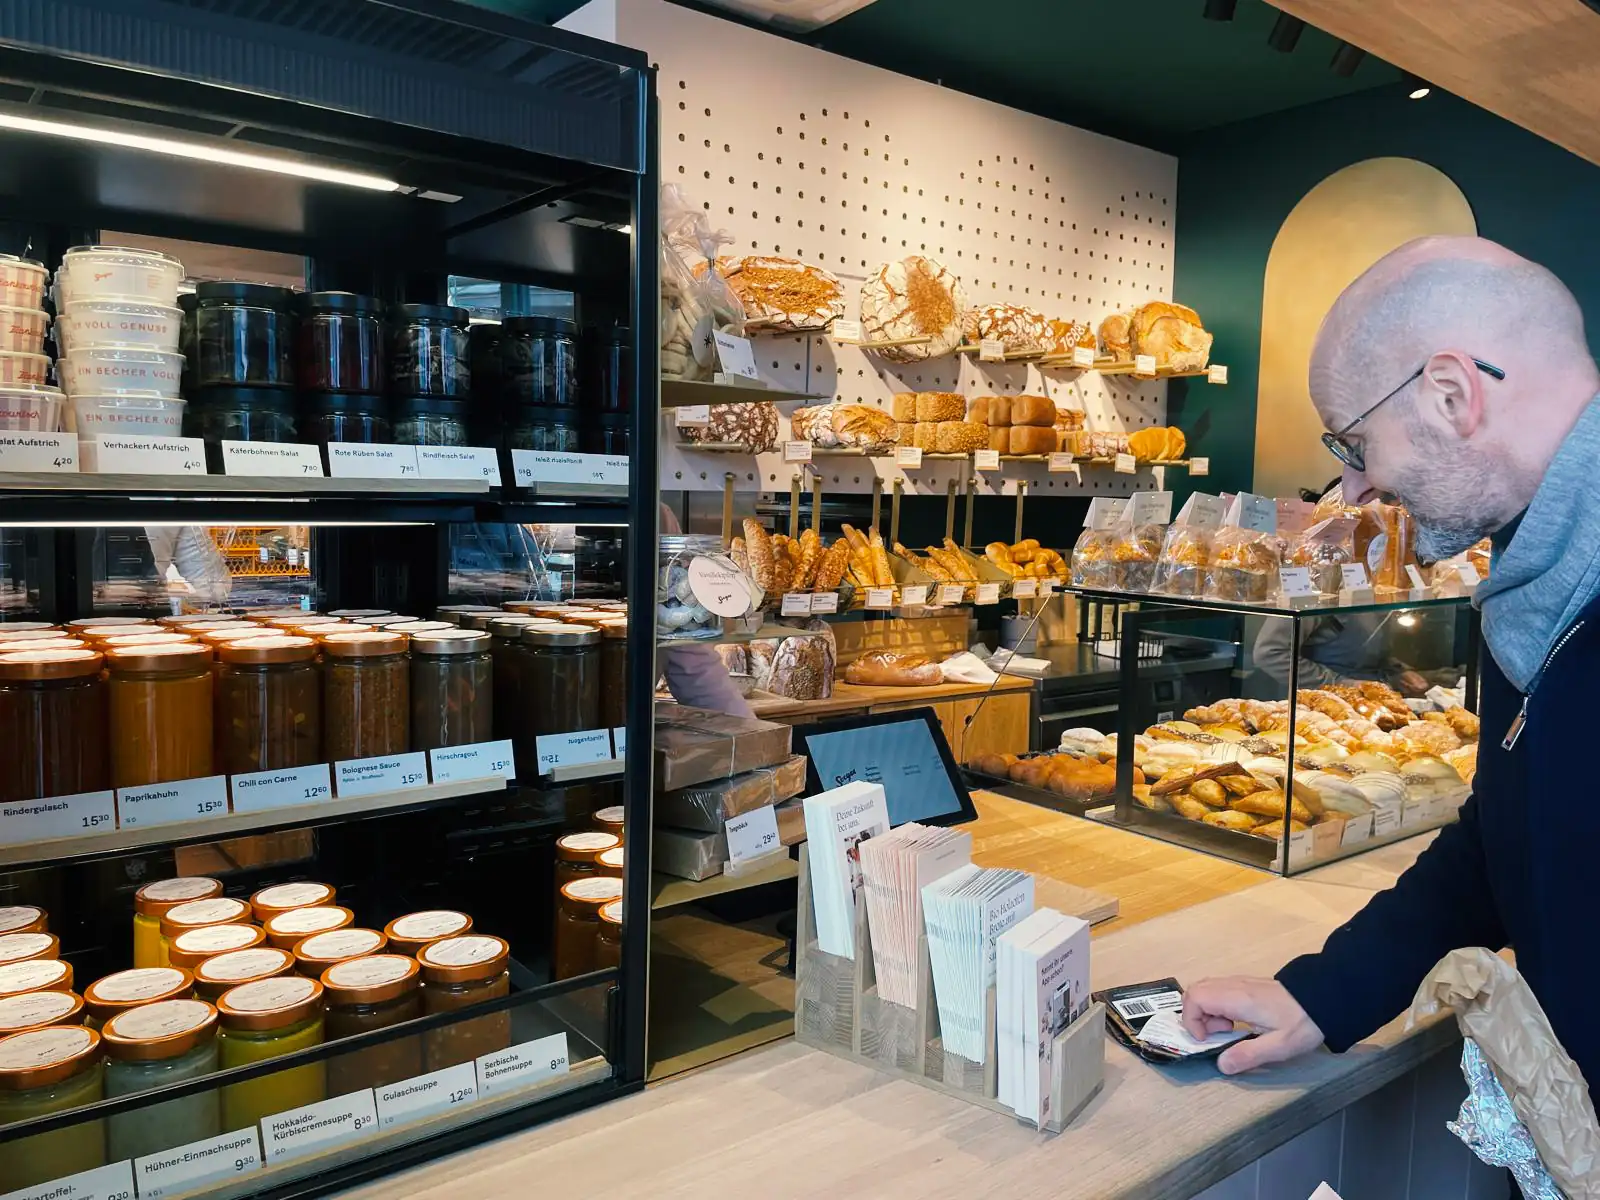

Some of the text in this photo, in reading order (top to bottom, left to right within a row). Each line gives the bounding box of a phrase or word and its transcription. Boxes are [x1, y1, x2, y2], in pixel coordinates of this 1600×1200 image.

[85, 321, 113, 329] VOLL
[120, 322, 167, 333] GENUSS
[1059, 325, 1085, 352] 1688
[96, 367, 147, 377] BECHER
[153, 370, 175, 380] VOLL
[86, 413, 103, 422] EIN
[108, 414, 158, 424] BECHER
[18, 438, 60, 448] Aufstrich
[104, 441, 190, 453] Verhackert Aufstrich
[229, 446, 299, 457] Käferbohnen Salat
[334, 449, 394, 458] Rote Rüben Salat
[422, 451, 457, 460] Rindfleisch
[437, 750, 478, 761] Hirschragout
[342, 761, 401, 775] Bolognese Sauce
[238, 775, 298, 788] Chili con Carne
[401, 773, 423, 785] 1530
[124, 790, 179, 804] Paprikahuhn
[3, 801, 69, 816] Rindergulasch
[197, 801, 223, 813] 1530
[82, 813, 110, 828] 1530
[484, 1053, 519, 1070] Serbische
[550, 1057, 565, 1070] 830
[485, 1060, 533, 1079] Bohnensuppe
[383, 1079, 438, 1102] Gulaschsuppe
[449, 1087, 473, 1104] 1260
[272, 1111, 317, 1133] Hokkaido-
[273, 1111, 353, 1141] Kürbiscremesuppe
[354, 1115, 371, 1130] 830
[145, 1136, 252, 1174] Hühner-Einmachsuppe
[235, 1155, 255, 1171] 930
